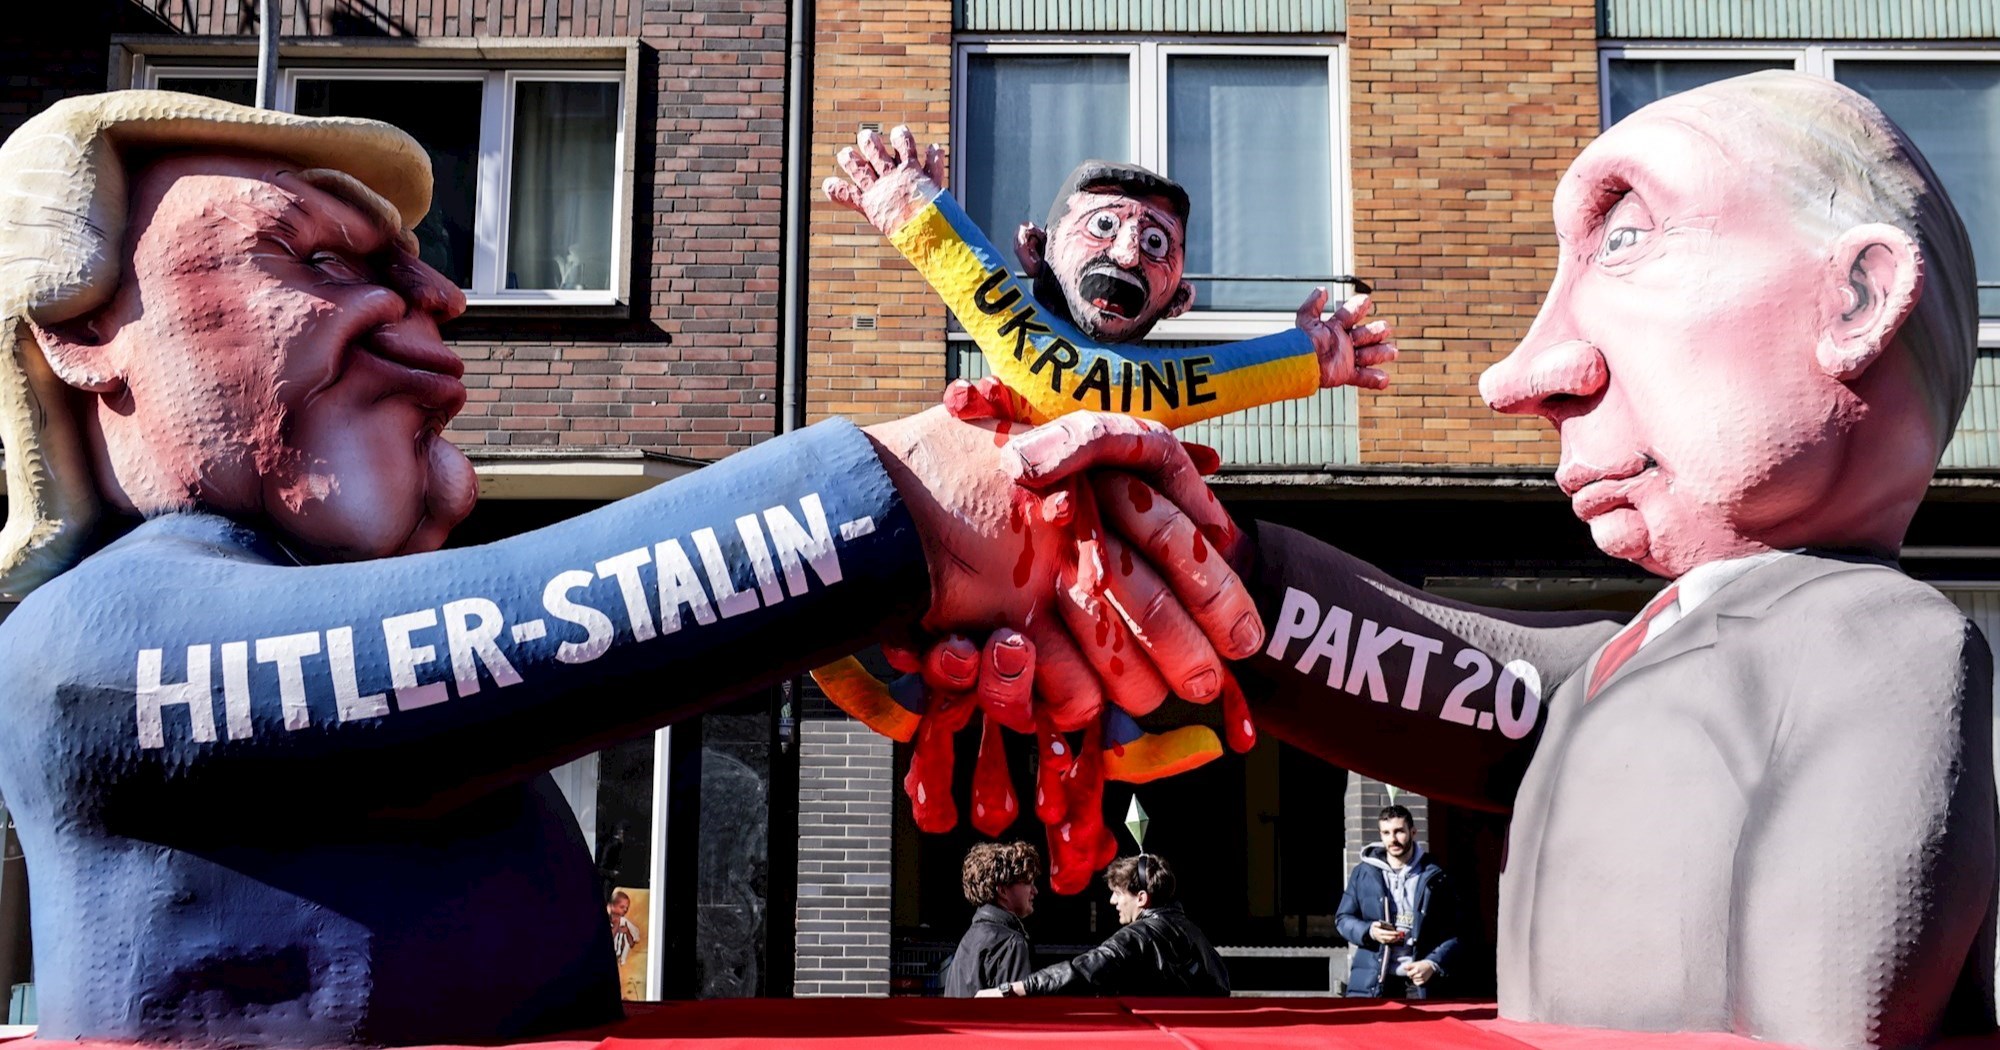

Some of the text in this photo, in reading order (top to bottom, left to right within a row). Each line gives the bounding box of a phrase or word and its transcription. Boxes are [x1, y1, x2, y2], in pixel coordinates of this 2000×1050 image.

[974, 268, 1216, 412] UKRAINE
[136, 493, 876, 749] HITLER-STALIN-
[1266, 586, 1541, 740] PAKT 2.0
